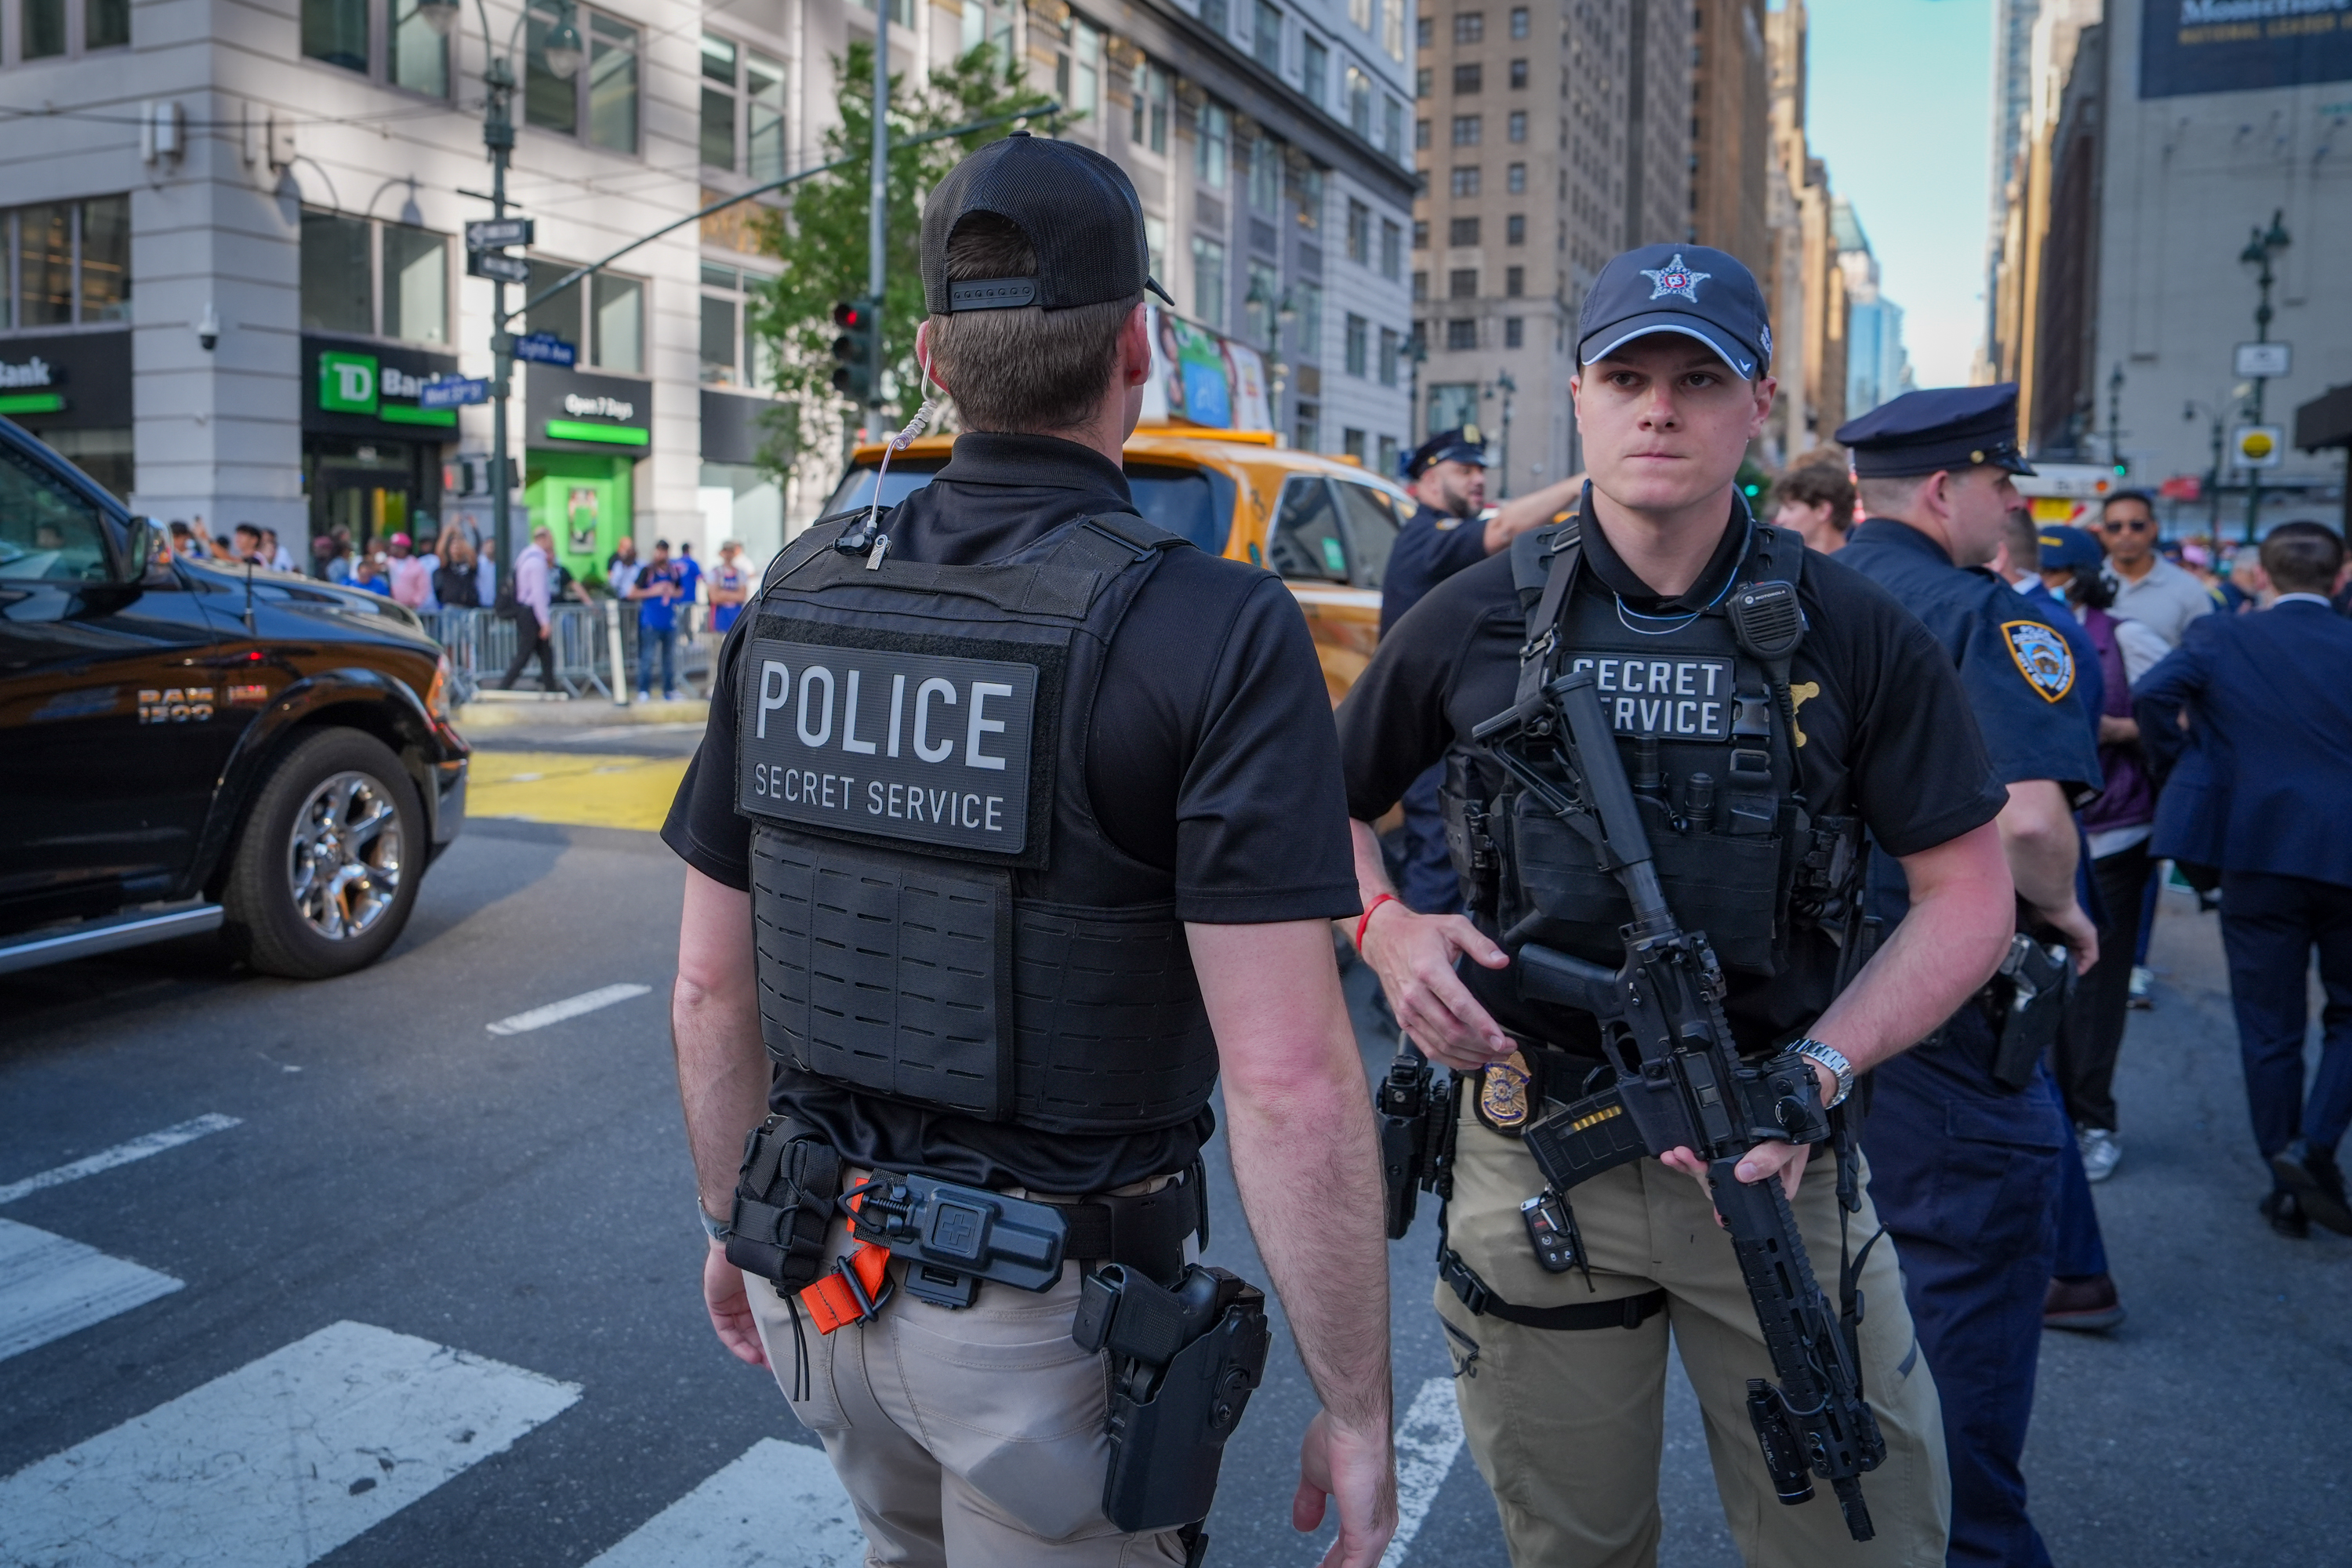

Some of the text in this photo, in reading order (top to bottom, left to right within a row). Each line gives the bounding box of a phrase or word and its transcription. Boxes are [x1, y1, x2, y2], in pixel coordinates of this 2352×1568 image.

[332, 361, 372, 402] TD
[565, 394, 633, 421] Open 7 Days
[1755, 590, 1786, 601] MOTOROLA
[755, 659, 1013, 771] POLICE
[1599, 696, 1721, 735] RVICE
[754, 763, 1004, 831] SECRET SERVICE
